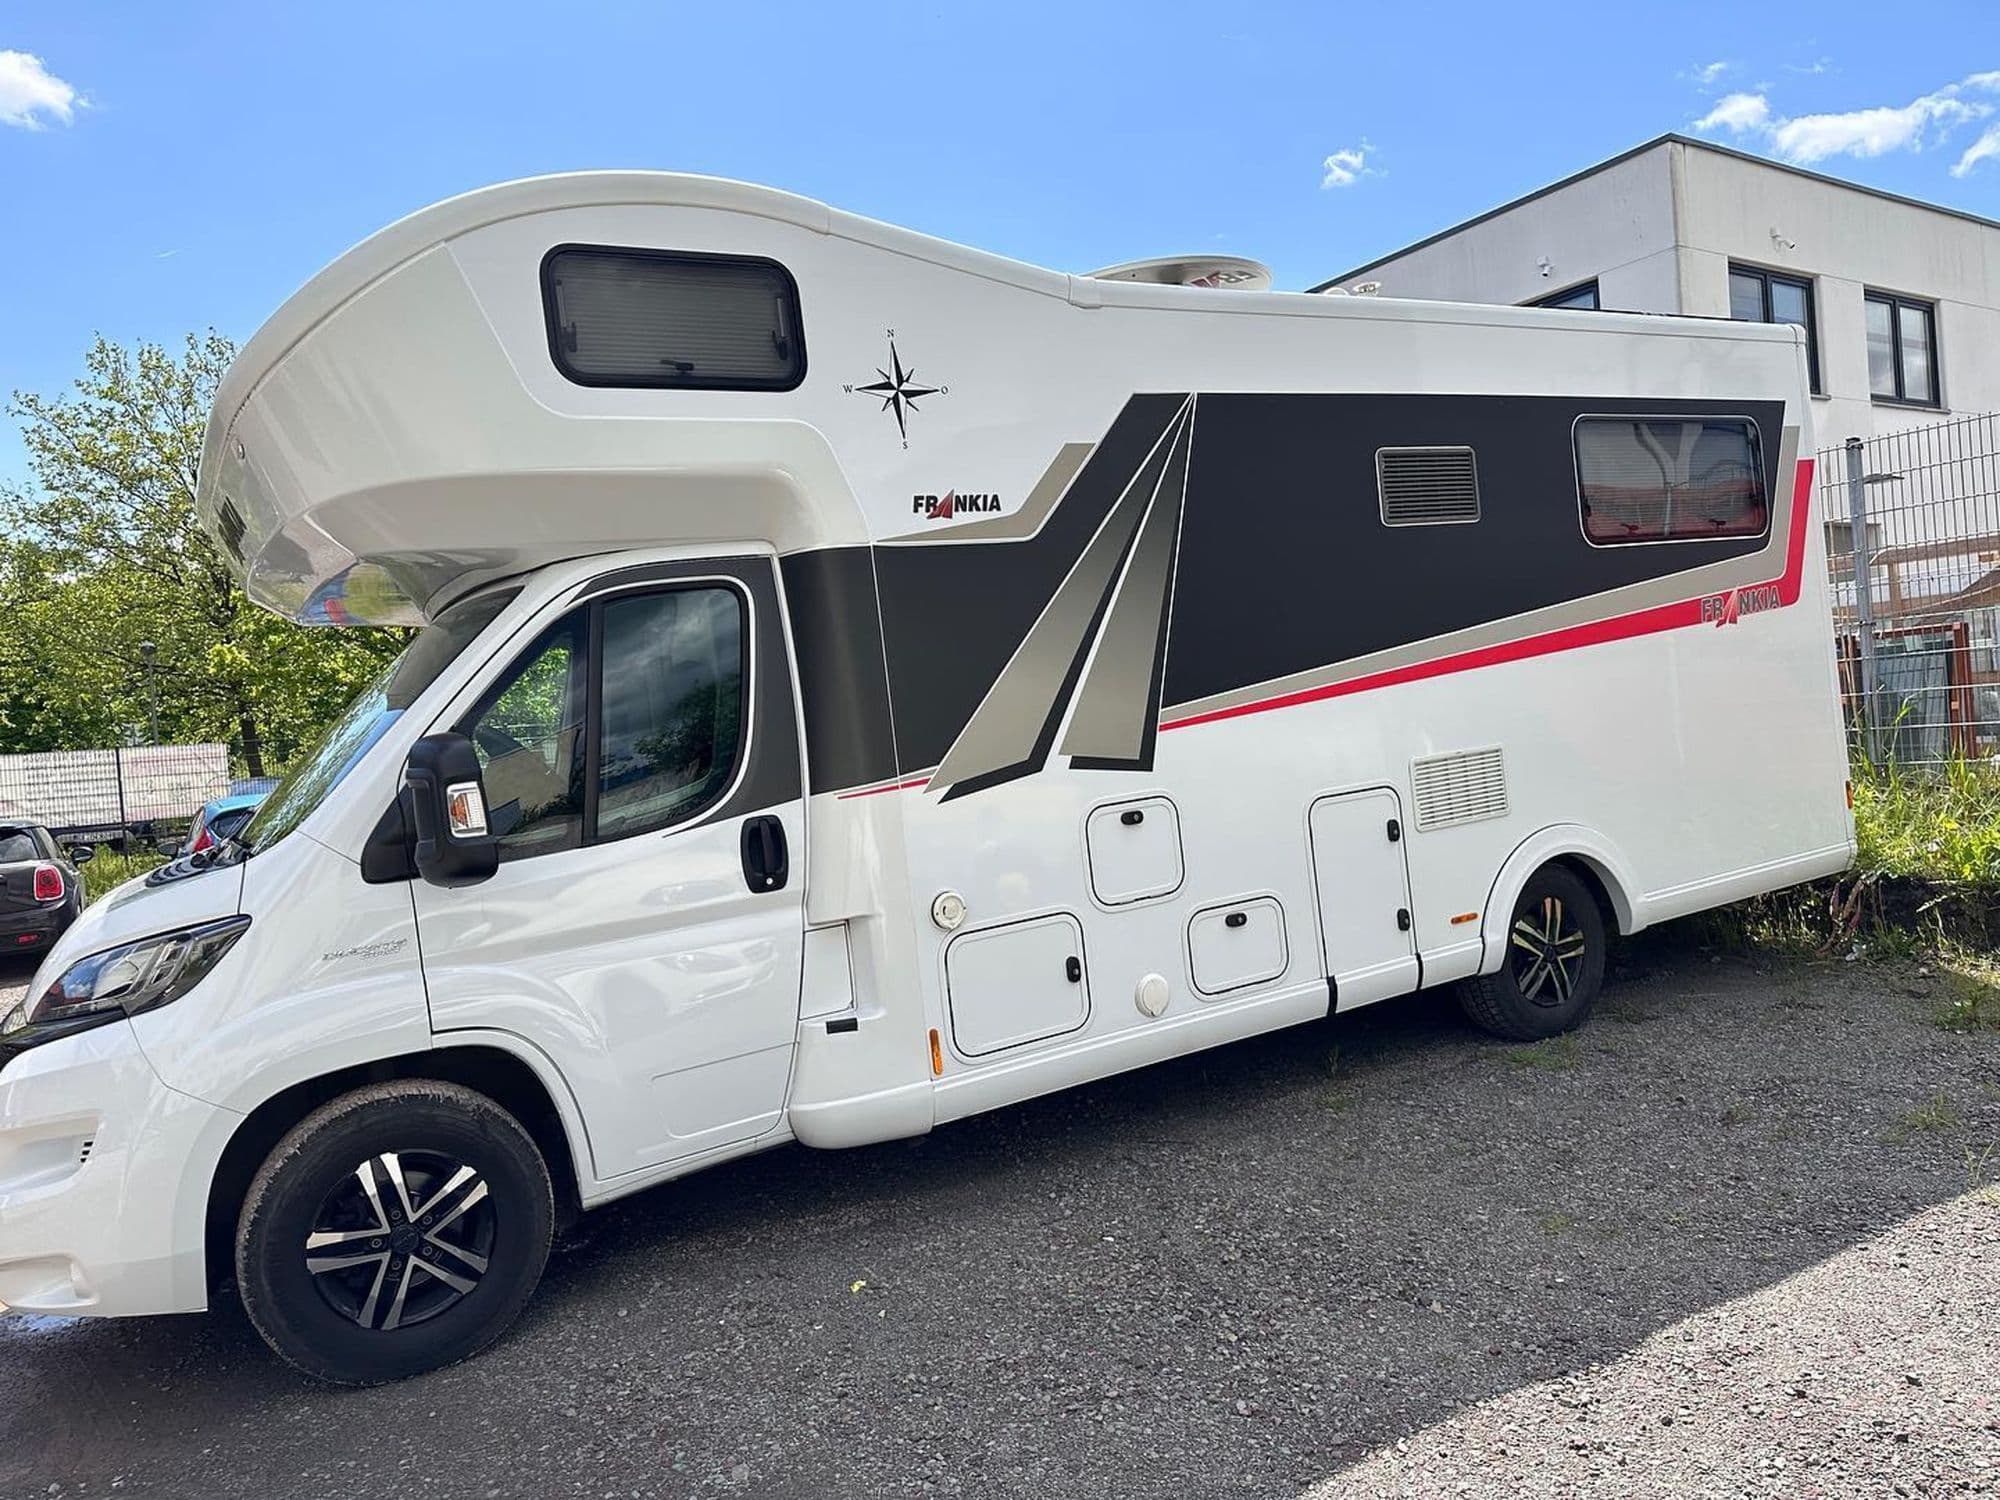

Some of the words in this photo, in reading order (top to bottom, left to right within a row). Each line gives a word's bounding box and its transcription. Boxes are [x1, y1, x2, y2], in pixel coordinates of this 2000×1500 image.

[886, 329, 895, 338] N
[843, 384, 853, 394] W
[940, 386, 949, 395] O
[902, 441, 909, 450] S
[912, 488, 1001, 520] FRANKIA
[1701, 586, 1780, 628] FRANKIA
